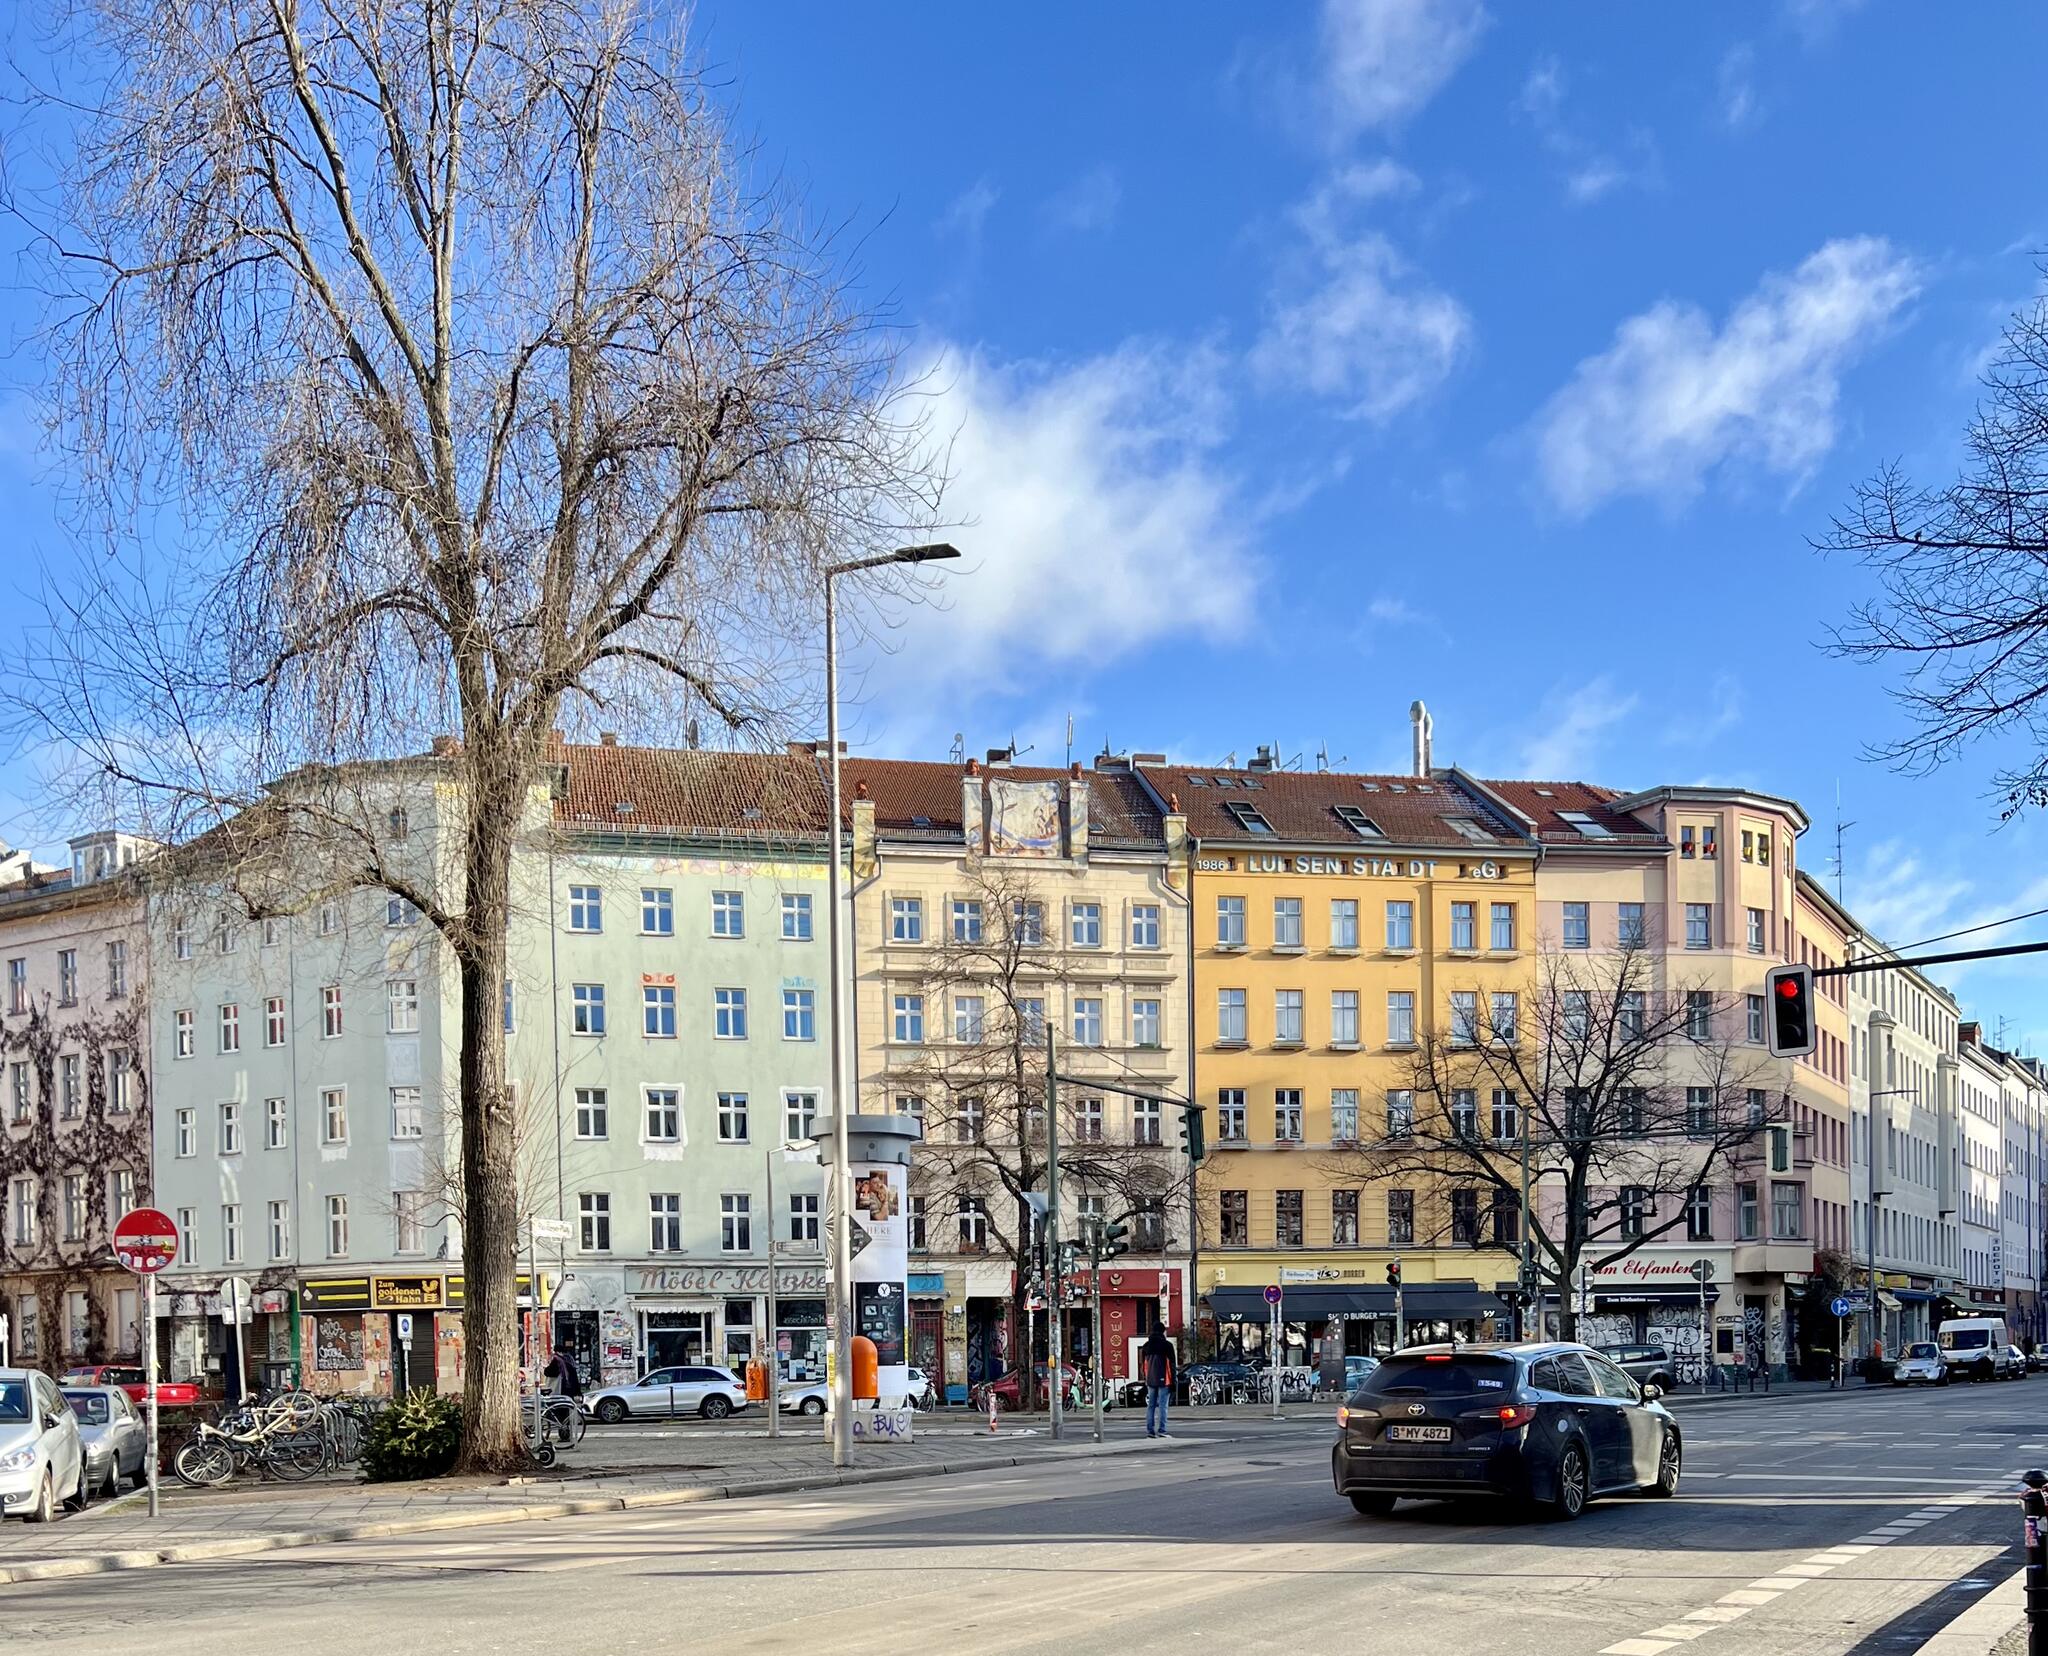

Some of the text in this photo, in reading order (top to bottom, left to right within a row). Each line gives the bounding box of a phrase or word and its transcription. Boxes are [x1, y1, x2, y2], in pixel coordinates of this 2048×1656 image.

[1197, 859, 1226, 870] 1986
[1472, 860, 1497, 878] eG
[1623, 1260, 1694, 1280] Elefanten
[378, 1280, 395, 1288] Zum
[378, 1287, 421, 1296] goldenen
[396, 1295, 421, 1303] Hahn
[1350, 1311, 1378, 1320] BURGER
[1392, 1427, 1449, 1438] B MY 4871
